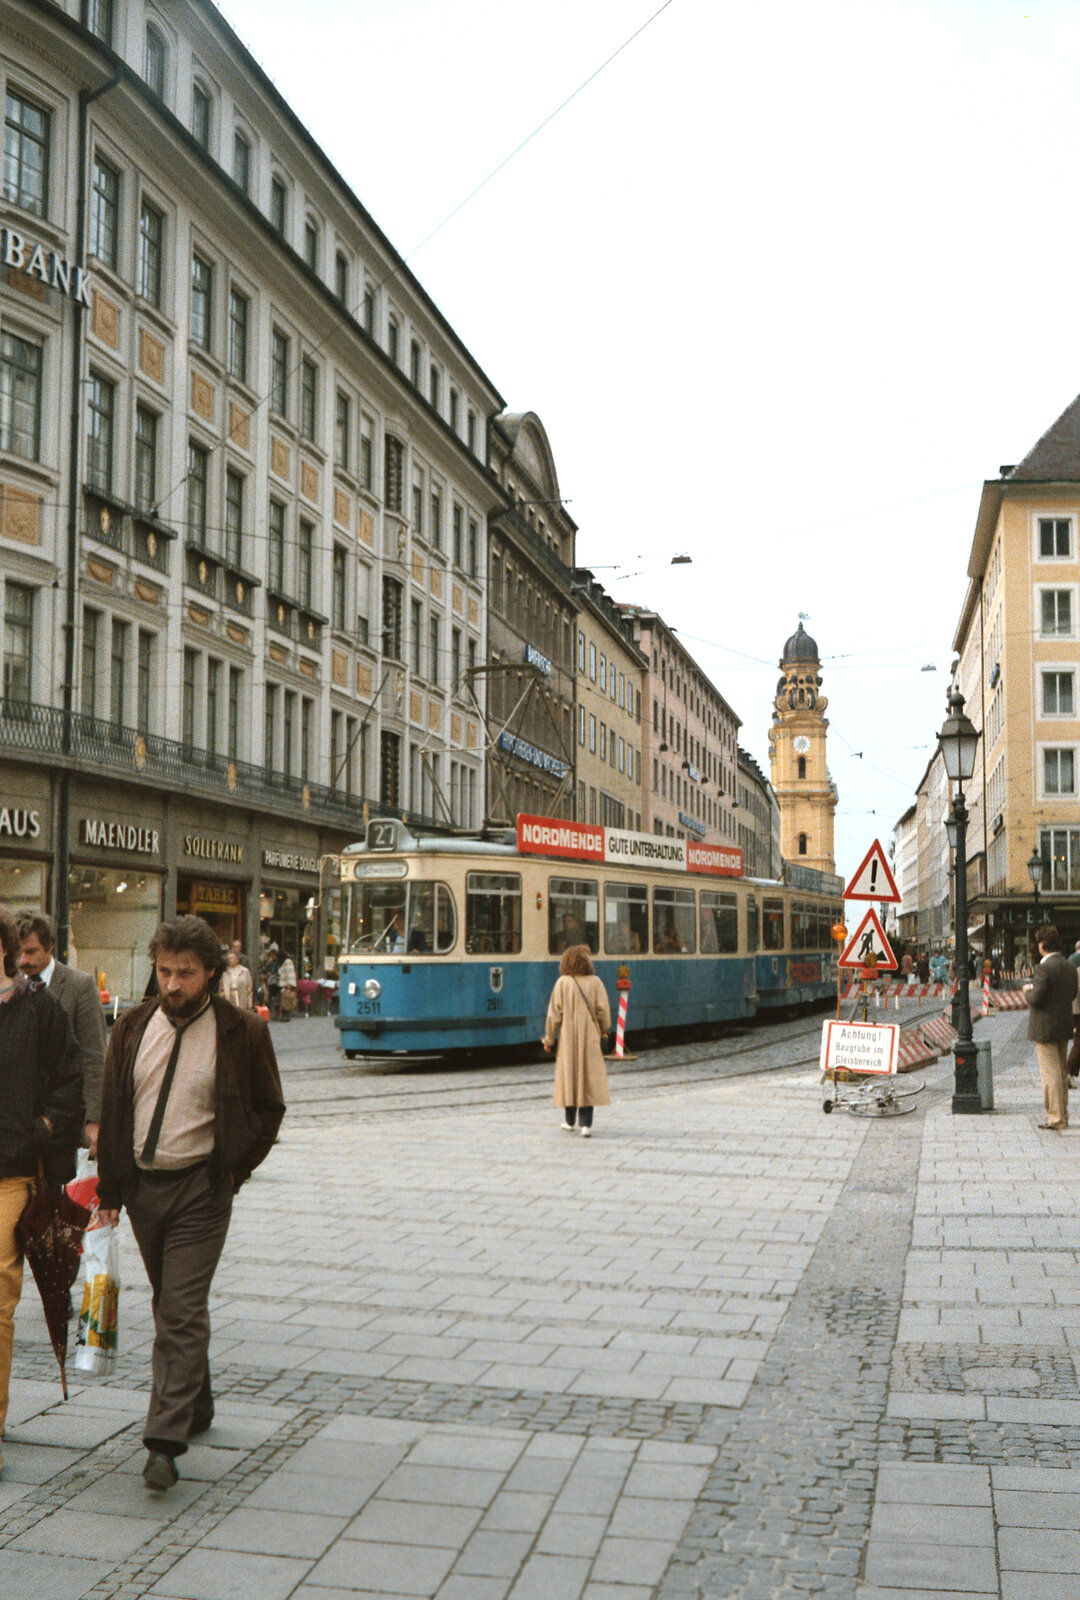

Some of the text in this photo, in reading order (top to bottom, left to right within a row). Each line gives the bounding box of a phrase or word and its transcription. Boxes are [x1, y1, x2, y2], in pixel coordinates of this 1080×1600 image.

[4, 228, 91, 307] BANK
[85, 818, 160, 854] MAENDLER
[375, 824, 395, 846] 27
[522, 822, 742, 869] NORDMENDE GUTE UNTERHALTUNG. NORDMENDE
[185, 835, 244, 864] SOLLFRANK
[199, 886, 236, 903] TABAC
[356, 1001, 382, 1015] 2511
[835, 1041, 885, 1054] Baugrube im
[835, 1054, 883, 1067] Gleisbereich
